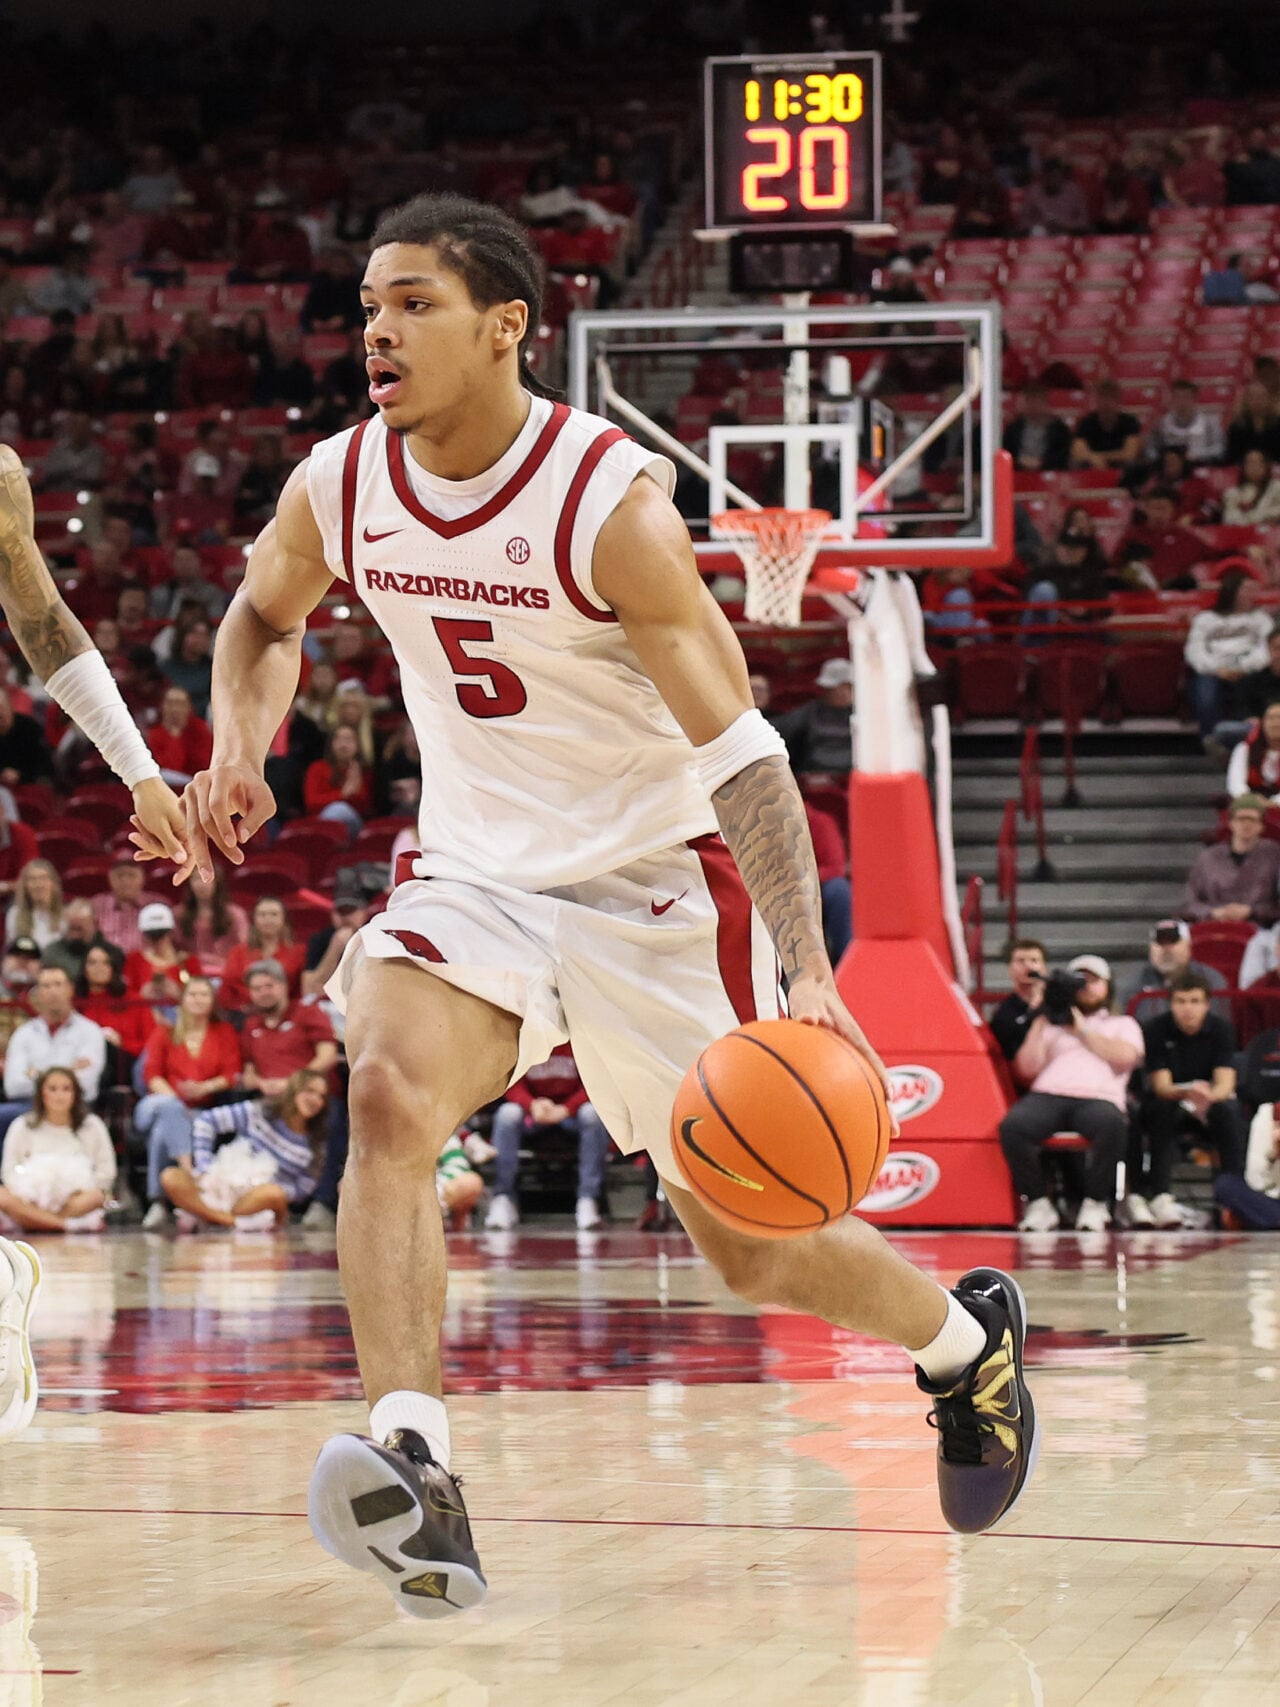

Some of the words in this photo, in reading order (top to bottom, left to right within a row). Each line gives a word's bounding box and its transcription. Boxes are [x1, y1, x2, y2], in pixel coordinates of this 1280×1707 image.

[745, 73, 863, 123] 11:30
[742, 126, 849, 212] 20
[506, 537, 530, 564] SEC
[363, 568, 550, 610] RAZORBACKS
[431, 616, 527, 719] 5
